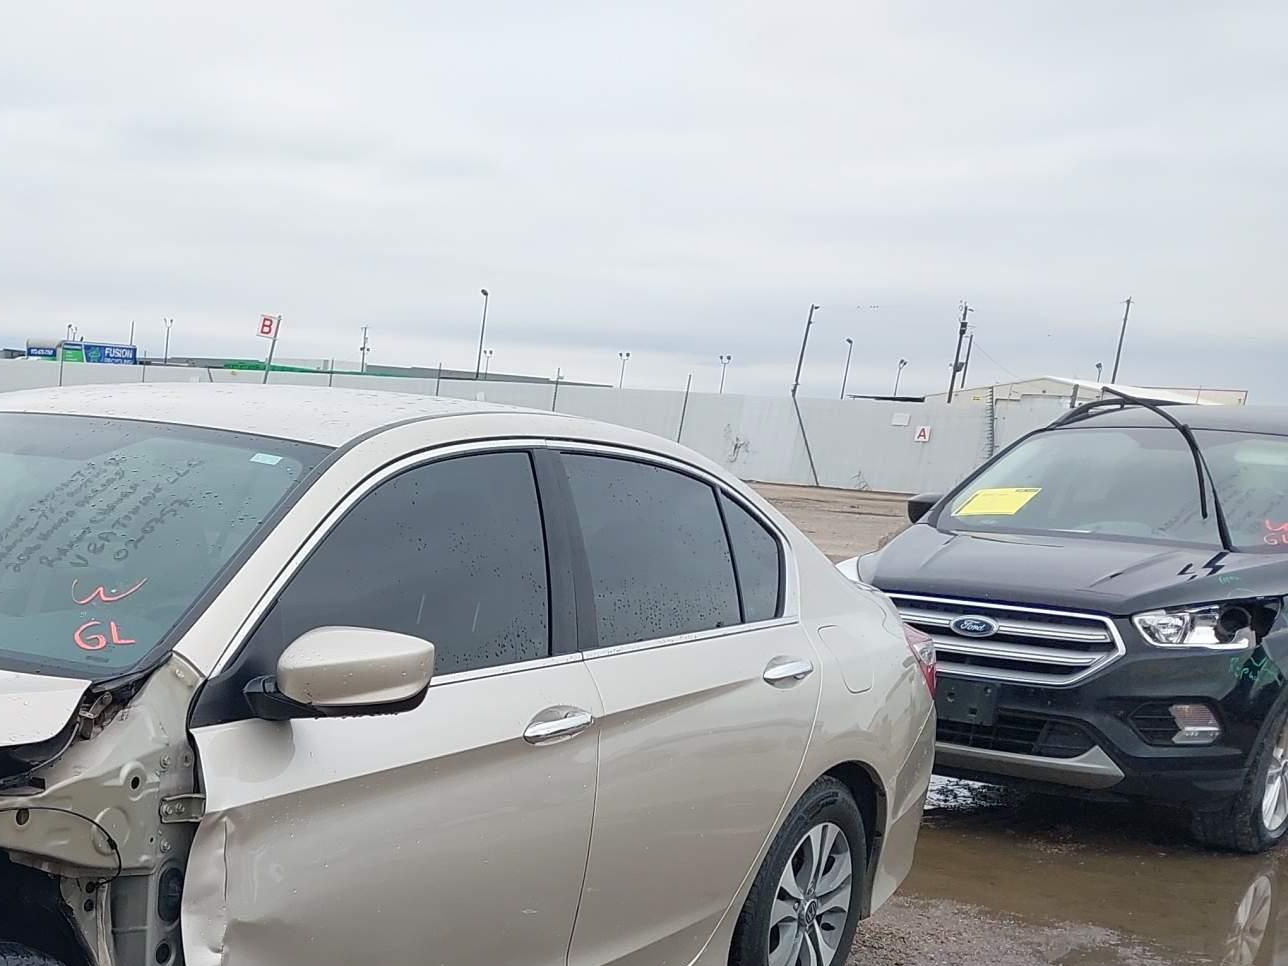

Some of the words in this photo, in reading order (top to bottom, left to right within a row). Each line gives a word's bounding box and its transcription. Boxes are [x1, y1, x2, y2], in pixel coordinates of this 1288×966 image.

[260, 317, 273, 335] B
[104, 347, 133, 359] FUSION
[917, 427, 927, 440] A
[960, 619, 986, 632] Ford
[73, 620, 136, 651] GL
